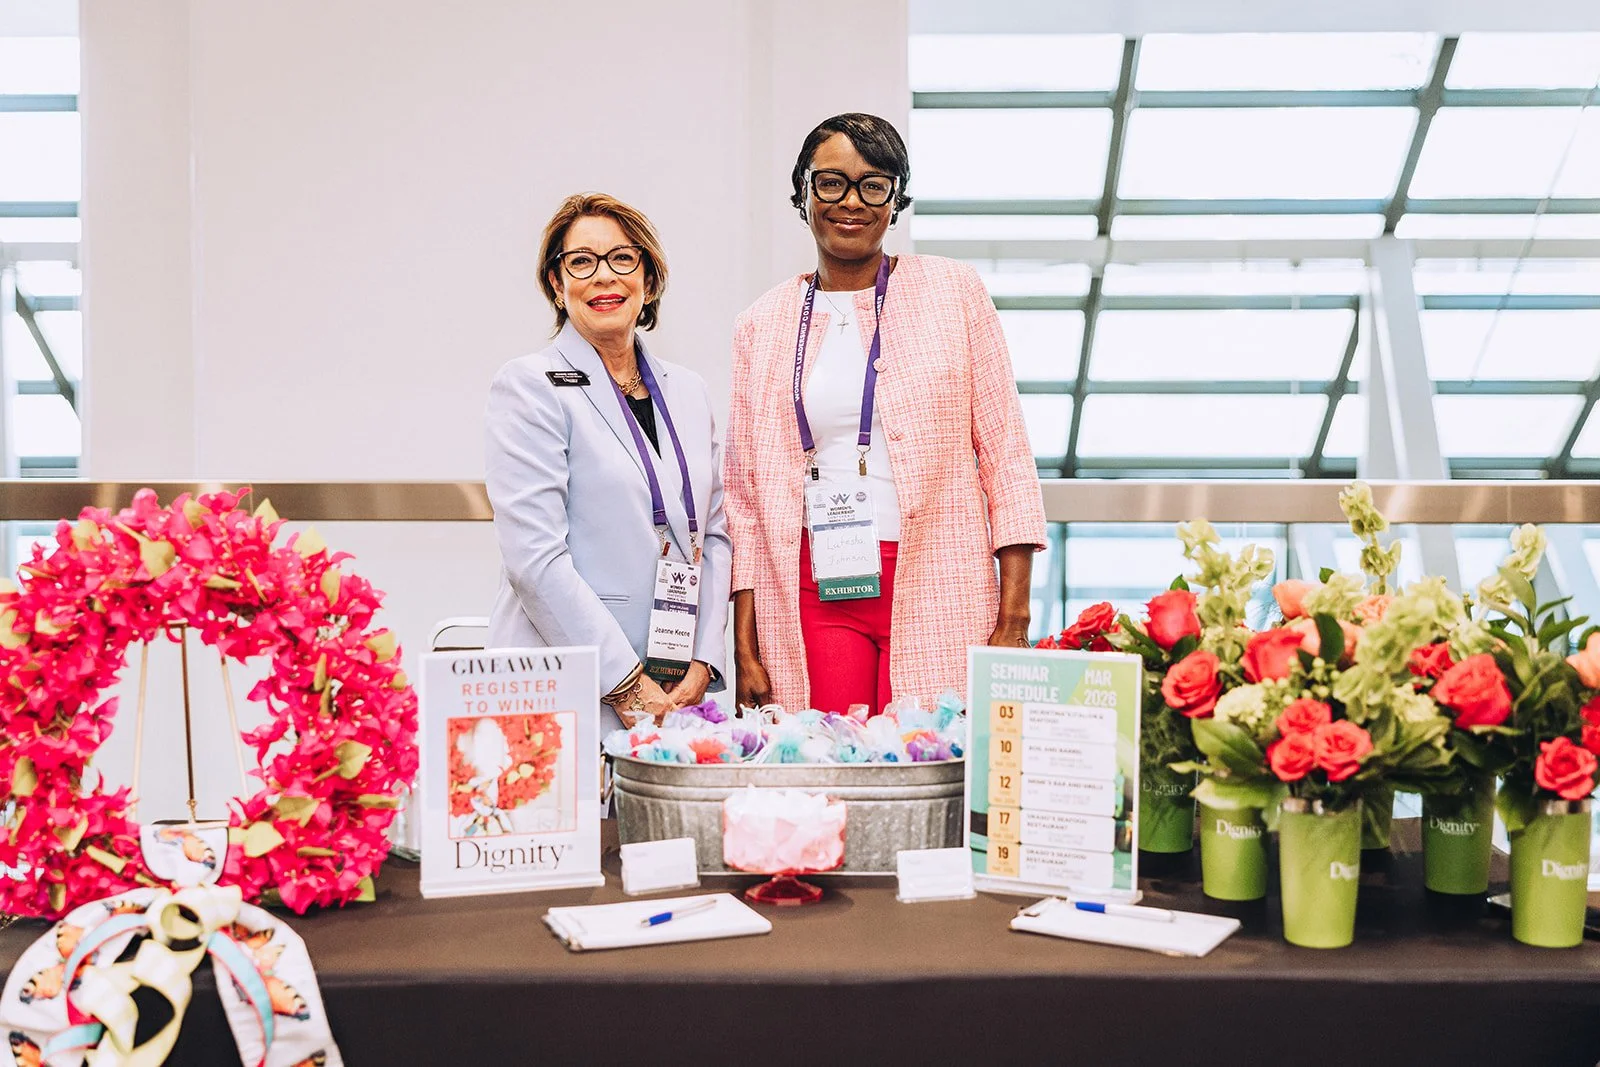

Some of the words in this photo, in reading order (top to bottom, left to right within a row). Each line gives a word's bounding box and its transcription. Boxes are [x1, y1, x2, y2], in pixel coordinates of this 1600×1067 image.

[796, 322, 808, 365] LEADERSHIP
[794, 366, 802, 402] WOMEN'S
[825, 584, 874, 596] EXHIBITOR
[451, 654, 567, 676] GIVEAWAY
[990, 662, 1050, 682] SEMINAR
[1084, 668, 1112, 688] MAR
[462, 680, 557, 696] REGISTER
[990, 683, 1060, 704] SCHEDULE
[465, 700, 488, 713] TO
[498, 698, 556, 712] WIN!!!
[999, 705, 1014, 720] 03
[1000, 740, 1012, 754] 10
[1000, 776, 1012, 790] 12
[999, 812, 1010, 825] 17
[1429, 816, 1476, 836] Dignity
[1216, 818, 1262, 839] Dignity
[455, 839, 564, 874] Dignity
[998, 846, 1009, 860] 19
